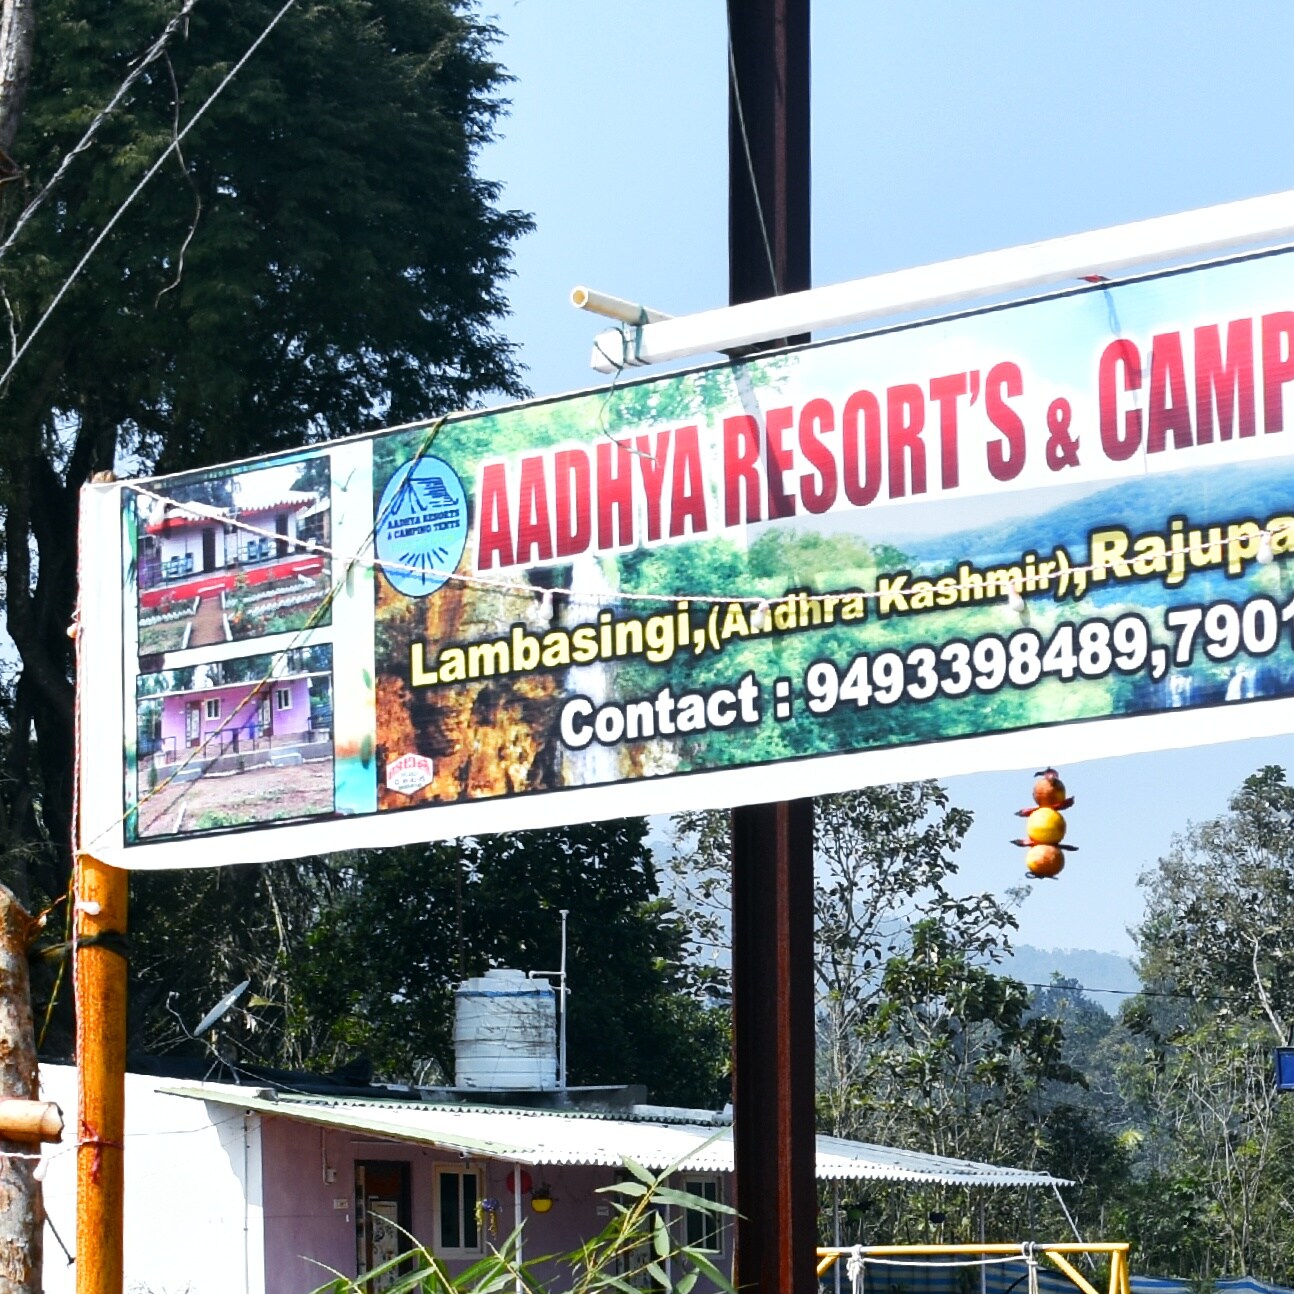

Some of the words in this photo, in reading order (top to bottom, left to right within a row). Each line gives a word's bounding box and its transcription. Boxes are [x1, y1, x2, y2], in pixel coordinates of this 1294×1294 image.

[477, 424, 707, 571] AADHYA
[723, 361, 1026, 528] RESORT'S
[1045, 398, 1081, 472] &
[560, 672, 760, 747] Contact
